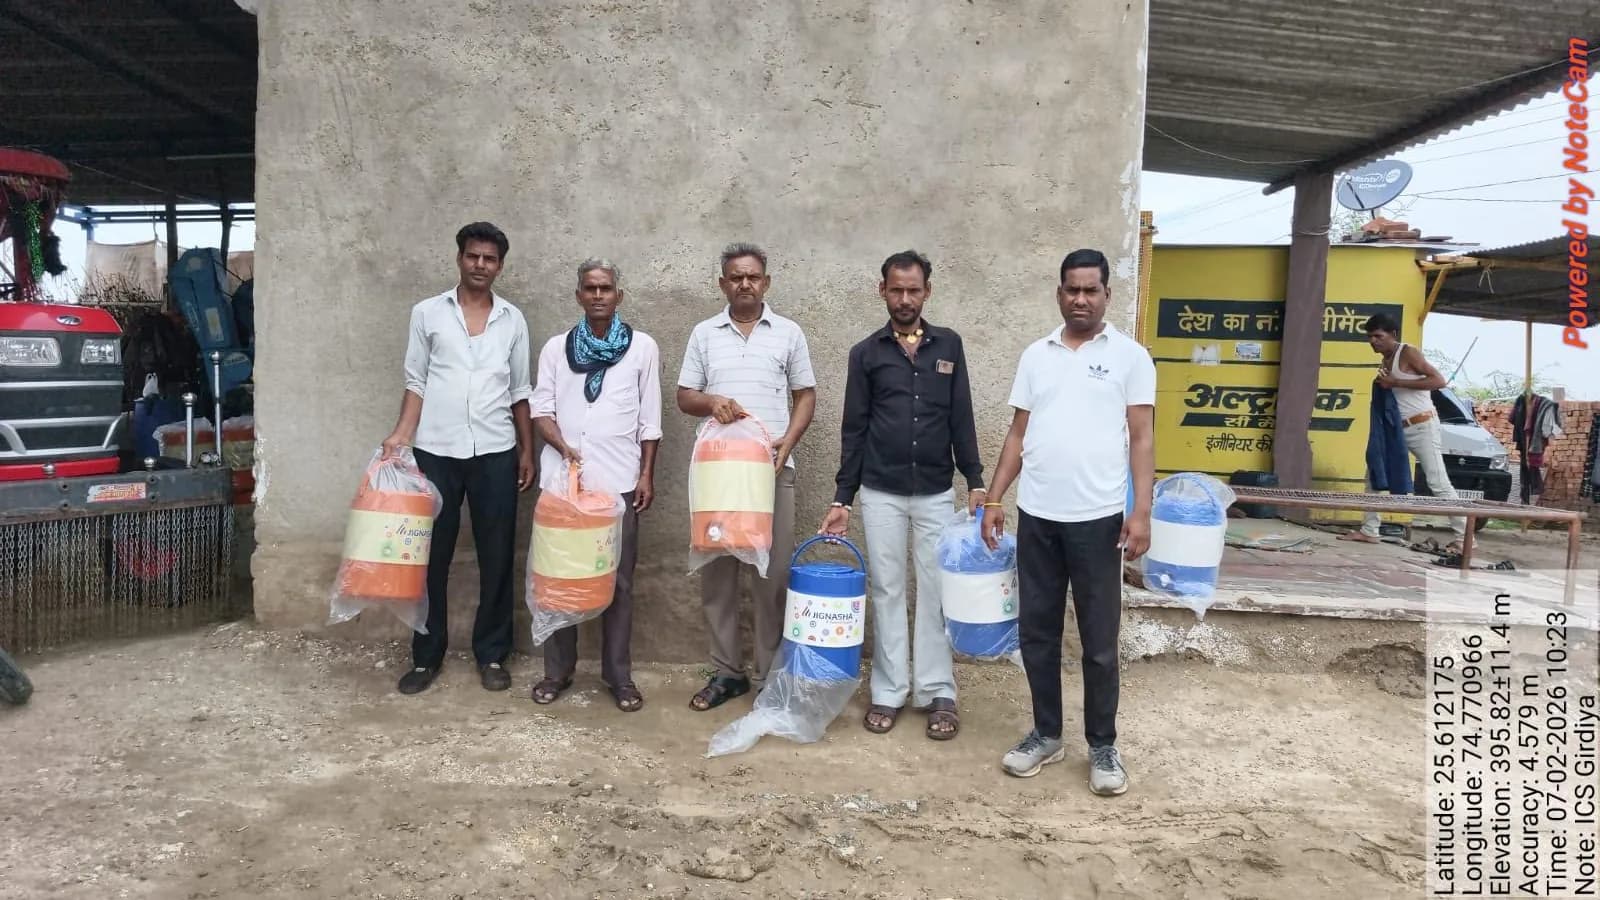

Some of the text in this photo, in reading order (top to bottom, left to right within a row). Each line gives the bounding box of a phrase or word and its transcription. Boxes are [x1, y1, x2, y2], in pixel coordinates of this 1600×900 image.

[1178, 305, 1214, 333] देश
[1223, 313, 1249, 332] का
[1323, 306, 1370, 334] ीमेंट
[1206, 432, 1254, 453] इंजीनियर
[812, 611, 853, 621] JIGNASHA
